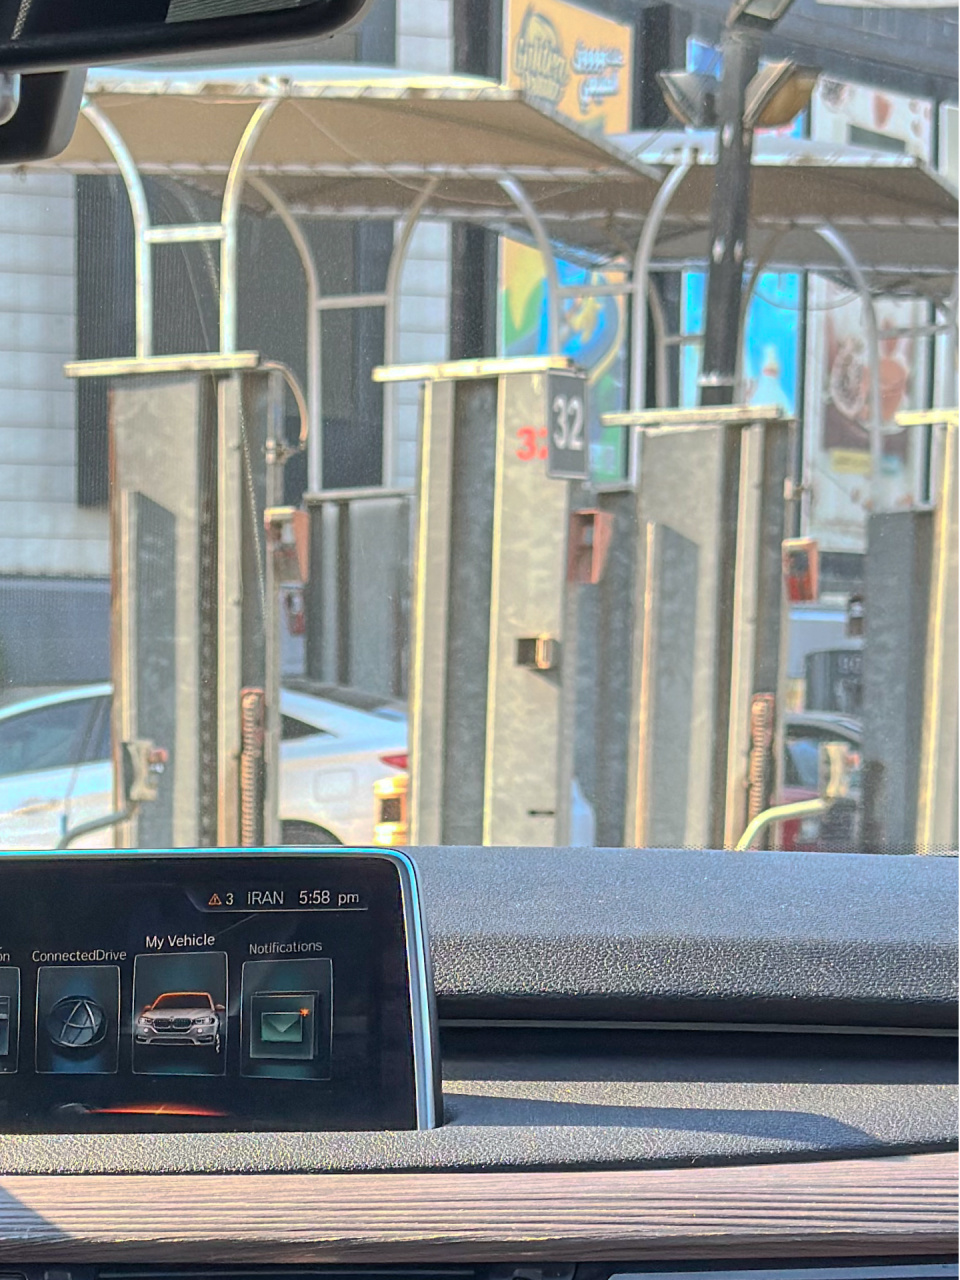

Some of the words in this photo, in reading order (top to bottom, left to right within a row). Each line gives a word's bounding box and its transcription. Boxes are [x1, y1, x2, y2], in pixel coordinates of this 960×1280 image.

[553, 395, 583, 450] 32
[226, 892, 234, 906] 3
[299, 890, 331, 904] 5:58
[338, 892, 360, 906] pm
[145, 936, 165, 950] My
[167, 933, 216, 948] Vehicle
[249, 941, 323, 955] Notifications
[32, 949, 127, 963] ConnectedDrive
